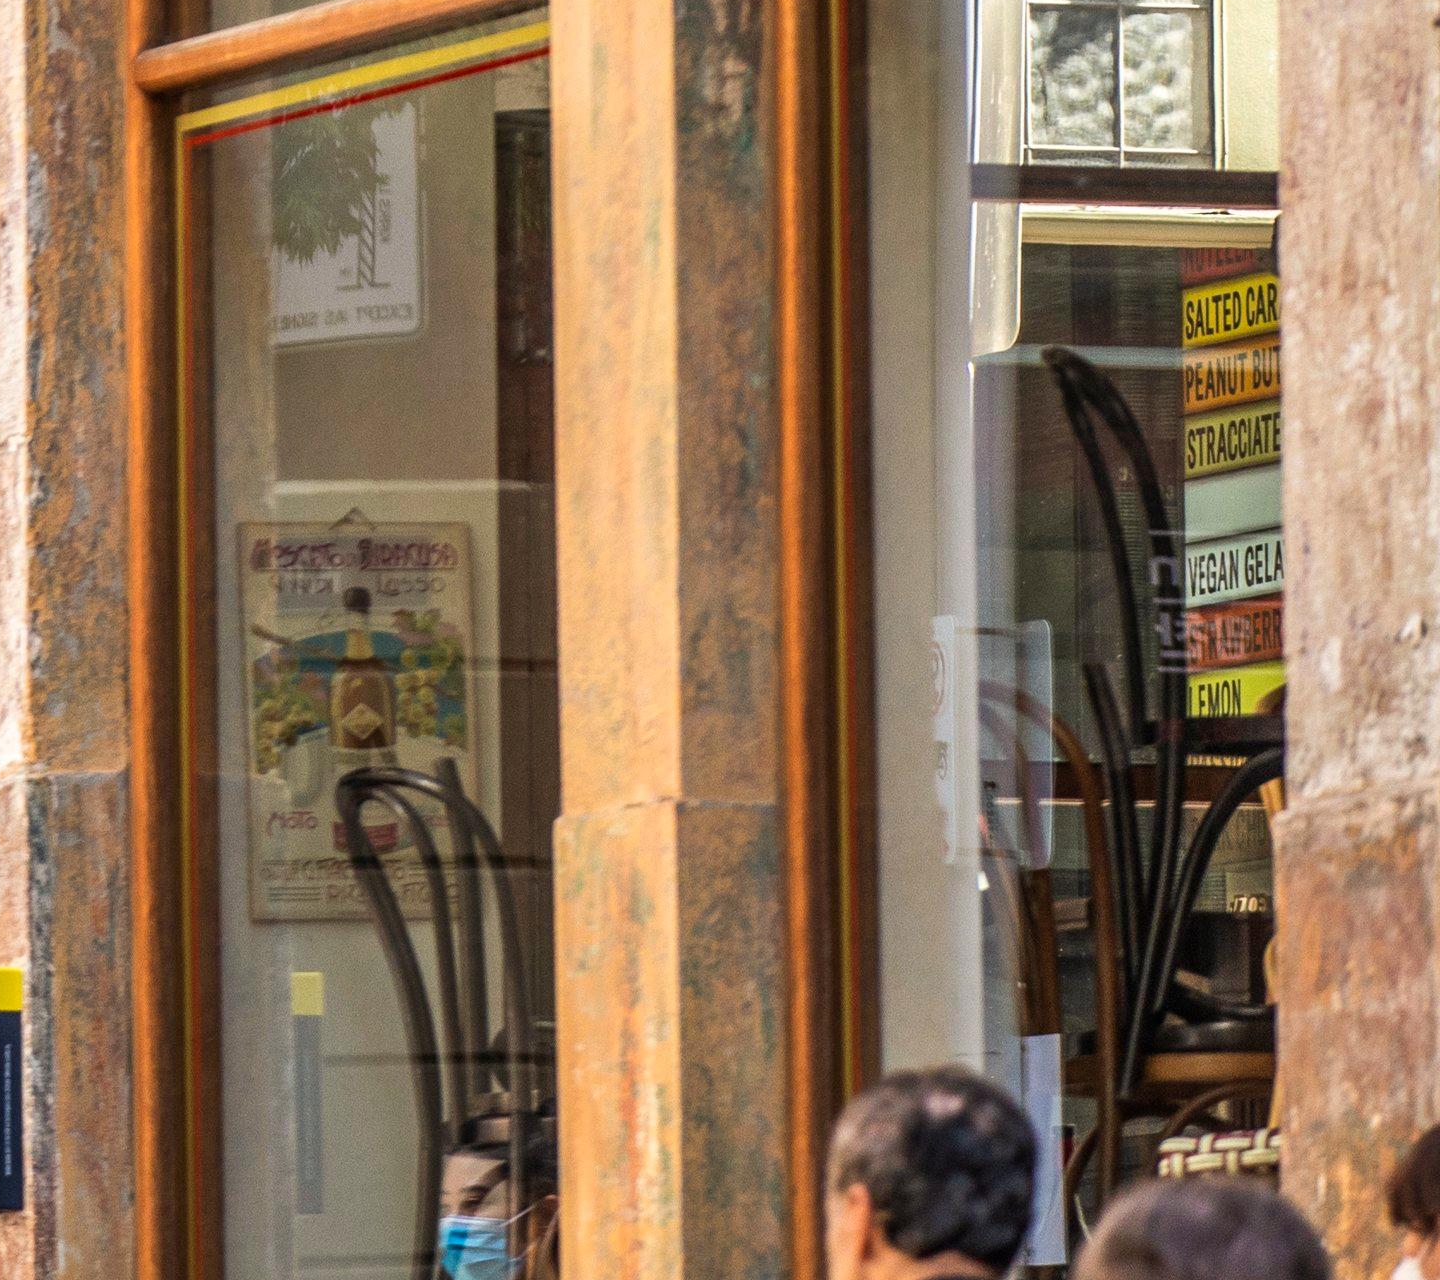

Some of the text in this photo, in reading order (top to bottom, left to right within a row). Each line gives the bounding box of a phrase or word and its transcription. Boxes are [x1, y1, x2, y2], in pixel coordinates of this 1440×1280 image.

[1184, 282, 1279, 340] SALTED CAR
[1184, 351, 1248, 403] PEANUT
[1187, 540, 1285, 597] VEGAN GELA
[1188, 677, 1242, 718] LEMON
